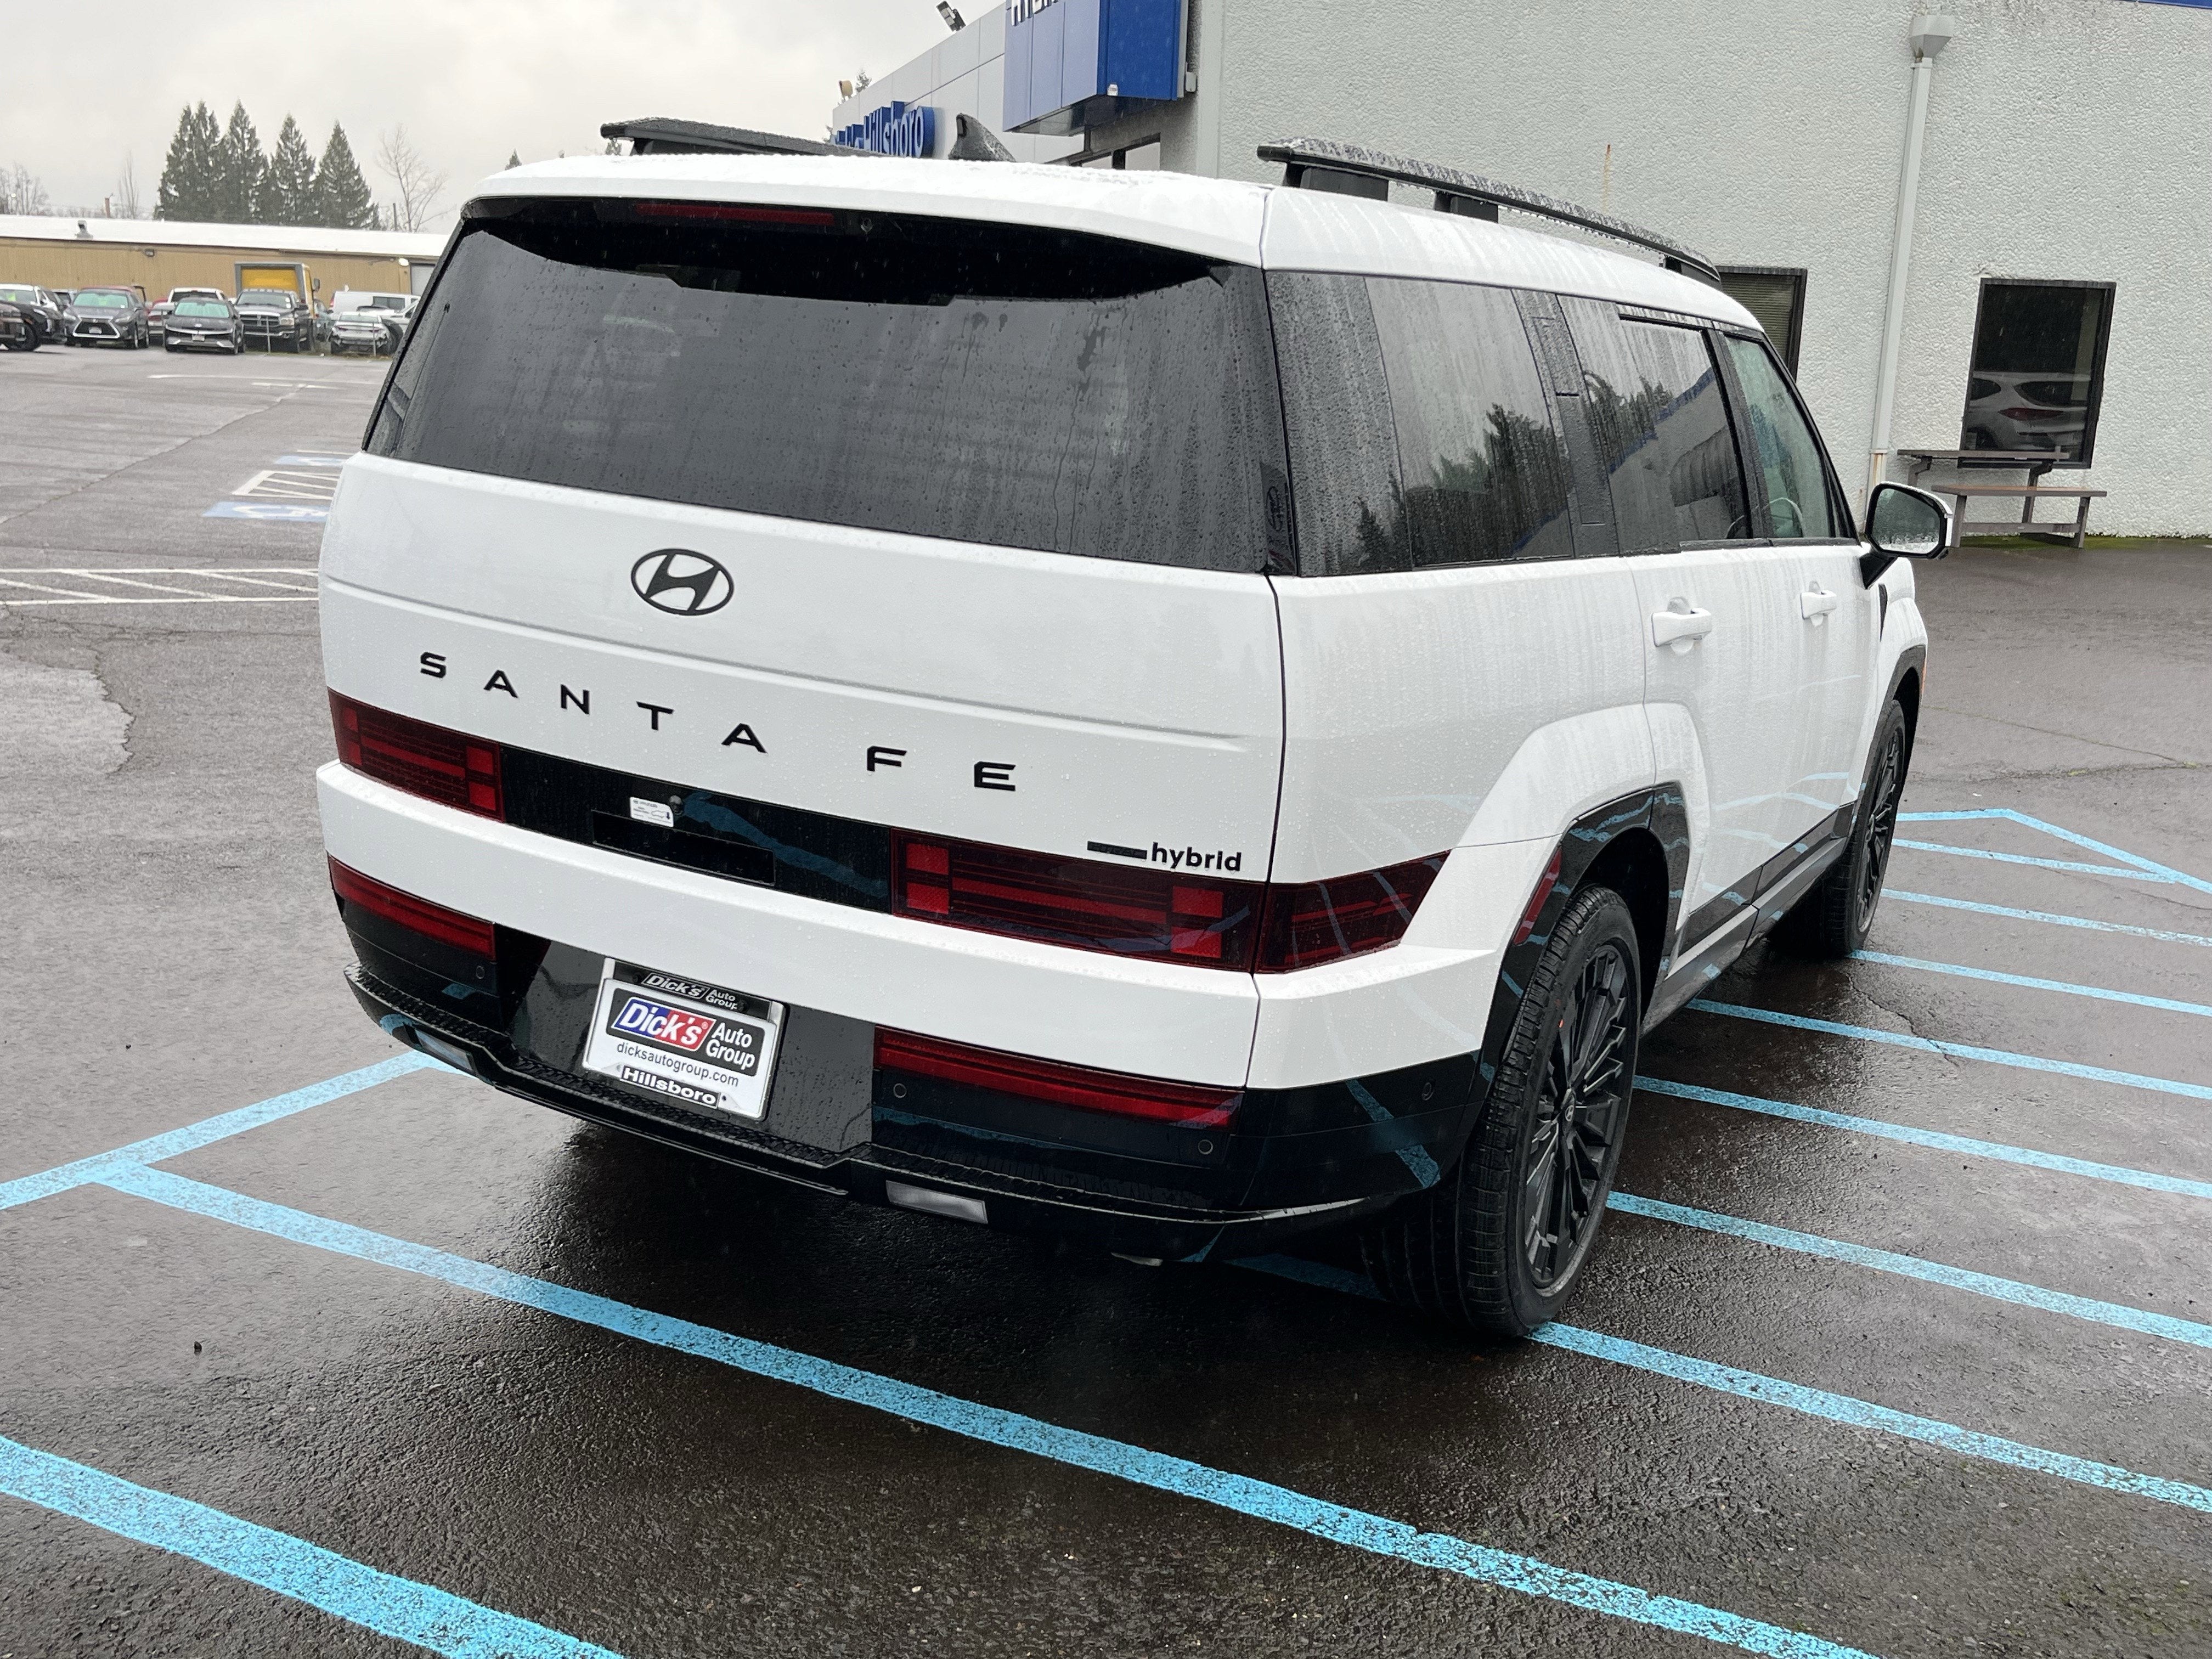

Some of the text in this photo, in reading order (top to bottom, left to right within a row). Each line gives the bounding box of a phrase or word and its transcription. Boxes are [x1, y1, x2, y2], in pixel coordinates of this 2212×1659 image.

[420, 651, 1017, 792] SANTA FE
[1152, 842, 1242, 871] hybrid
[647, 975, 703, 996] Dick's
[709, 989, 736, 1002] Auto
[619, 1003, 702, 1045] Dick's
[712, 1022, 753, 1048] Auto
[617, 1041, 739, 1087] dicksautogroup.com
[705, 1039, 755, 1070] Group
[623, 1067, 717, 1105] Hillsboro
